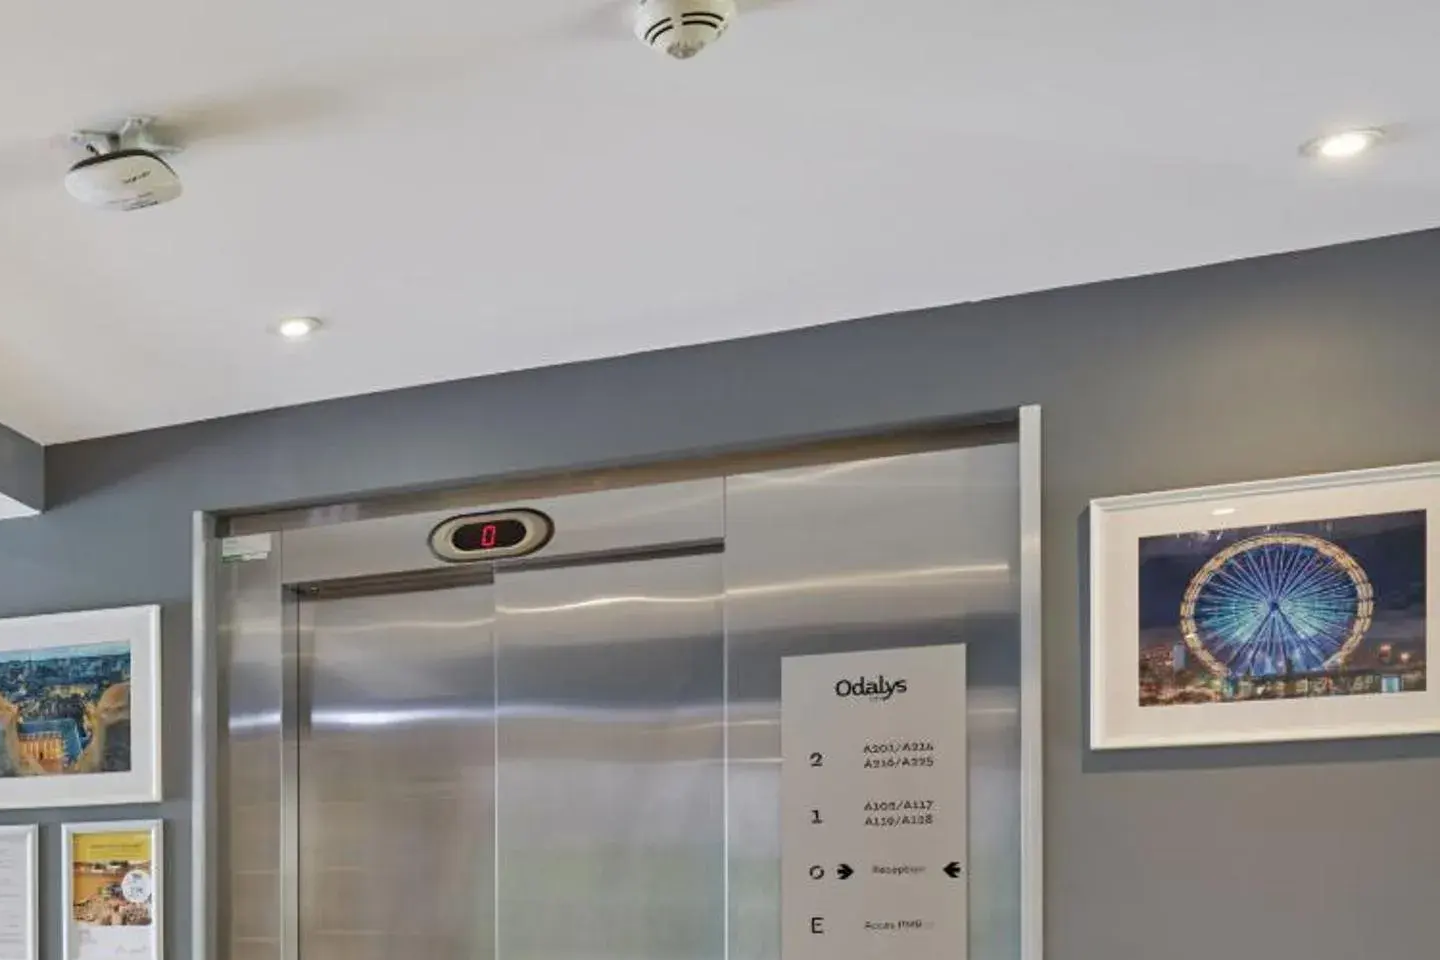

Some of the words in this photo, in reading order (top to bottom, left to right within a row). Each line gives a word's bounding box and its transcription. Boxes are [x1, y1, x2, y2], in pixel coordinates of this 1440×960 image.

[481, 523, 497, 547] 0
[835, 675, 908, 701] Odalys
[810, 752, 823, 767] 2
[811, 809, 824, 824] 1
[811, 916, 825, 934] E
